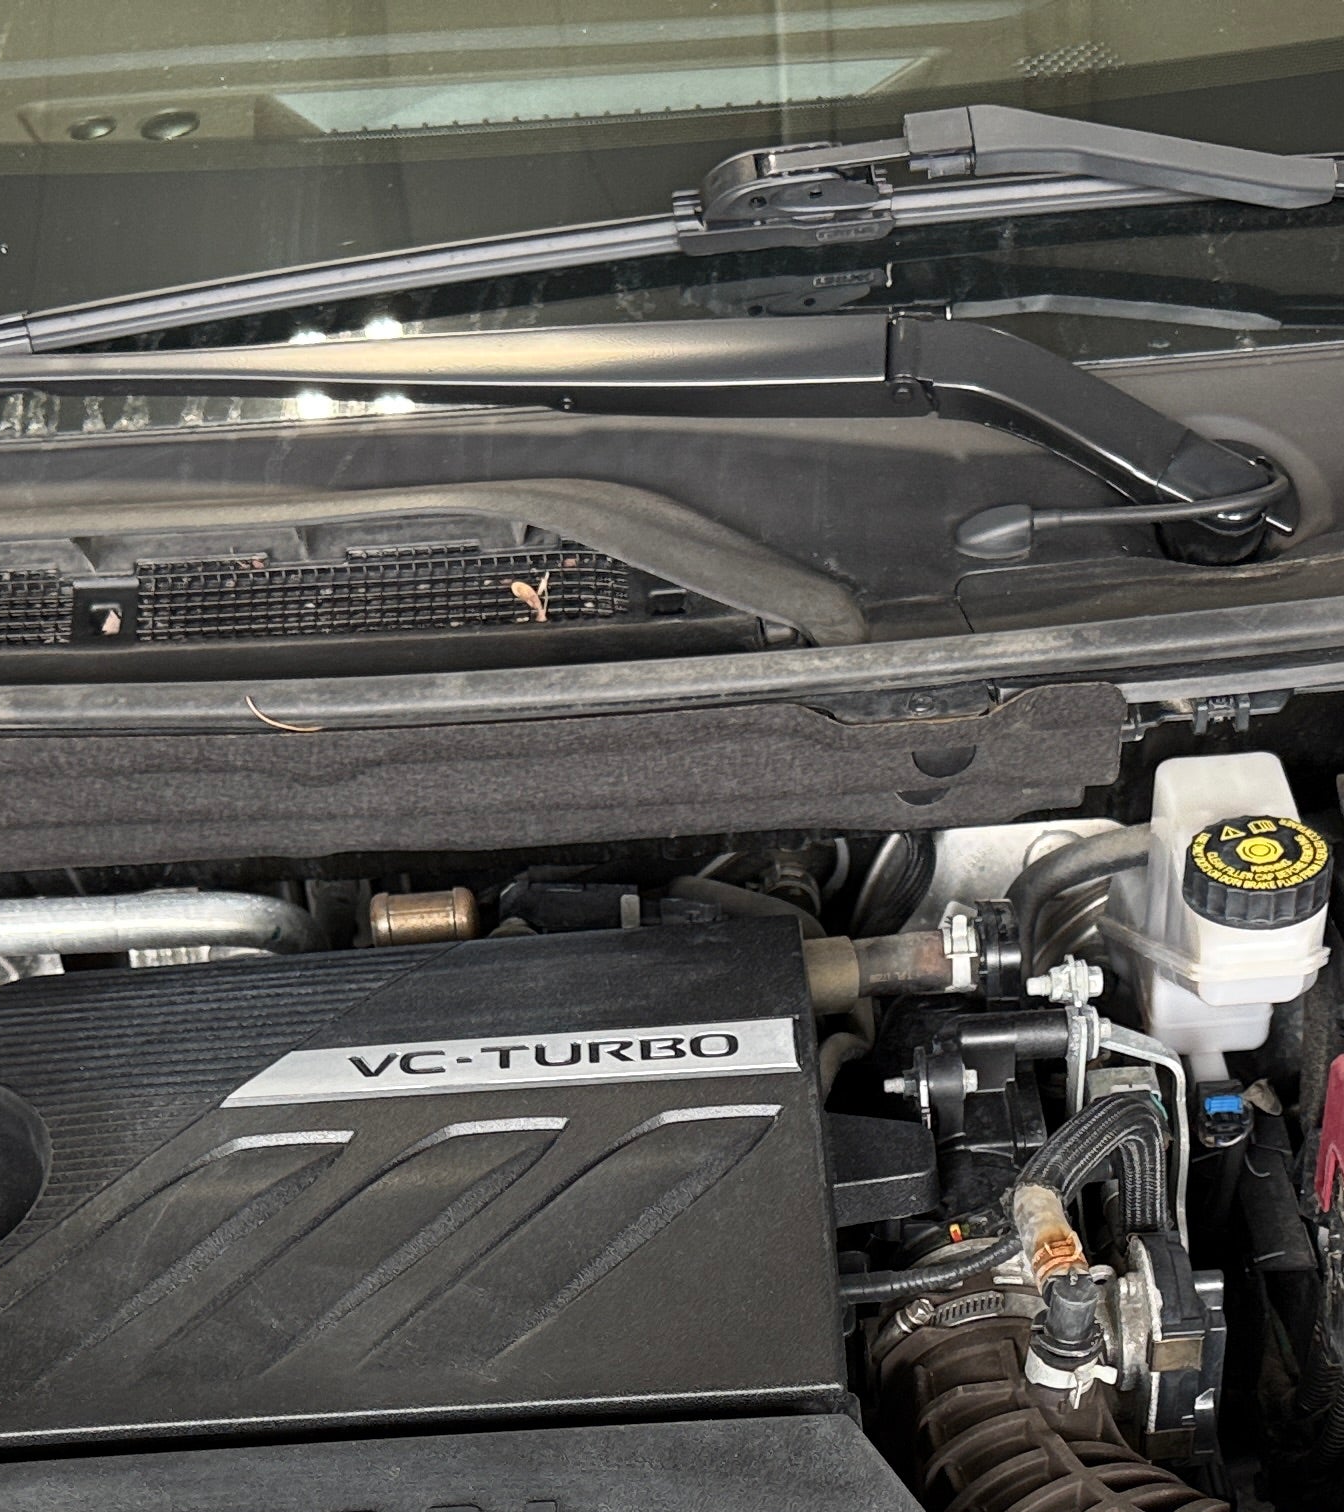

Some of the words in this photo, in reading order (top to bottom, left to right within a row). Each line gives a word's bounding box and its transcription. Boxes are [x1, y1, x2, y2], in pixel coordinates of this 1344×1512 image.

[1255, 872, 1275, 880] CAP
[1243, 880, 1276, 889] BRAKE
[348, 1033, 741, 1078] VC-TURBO
